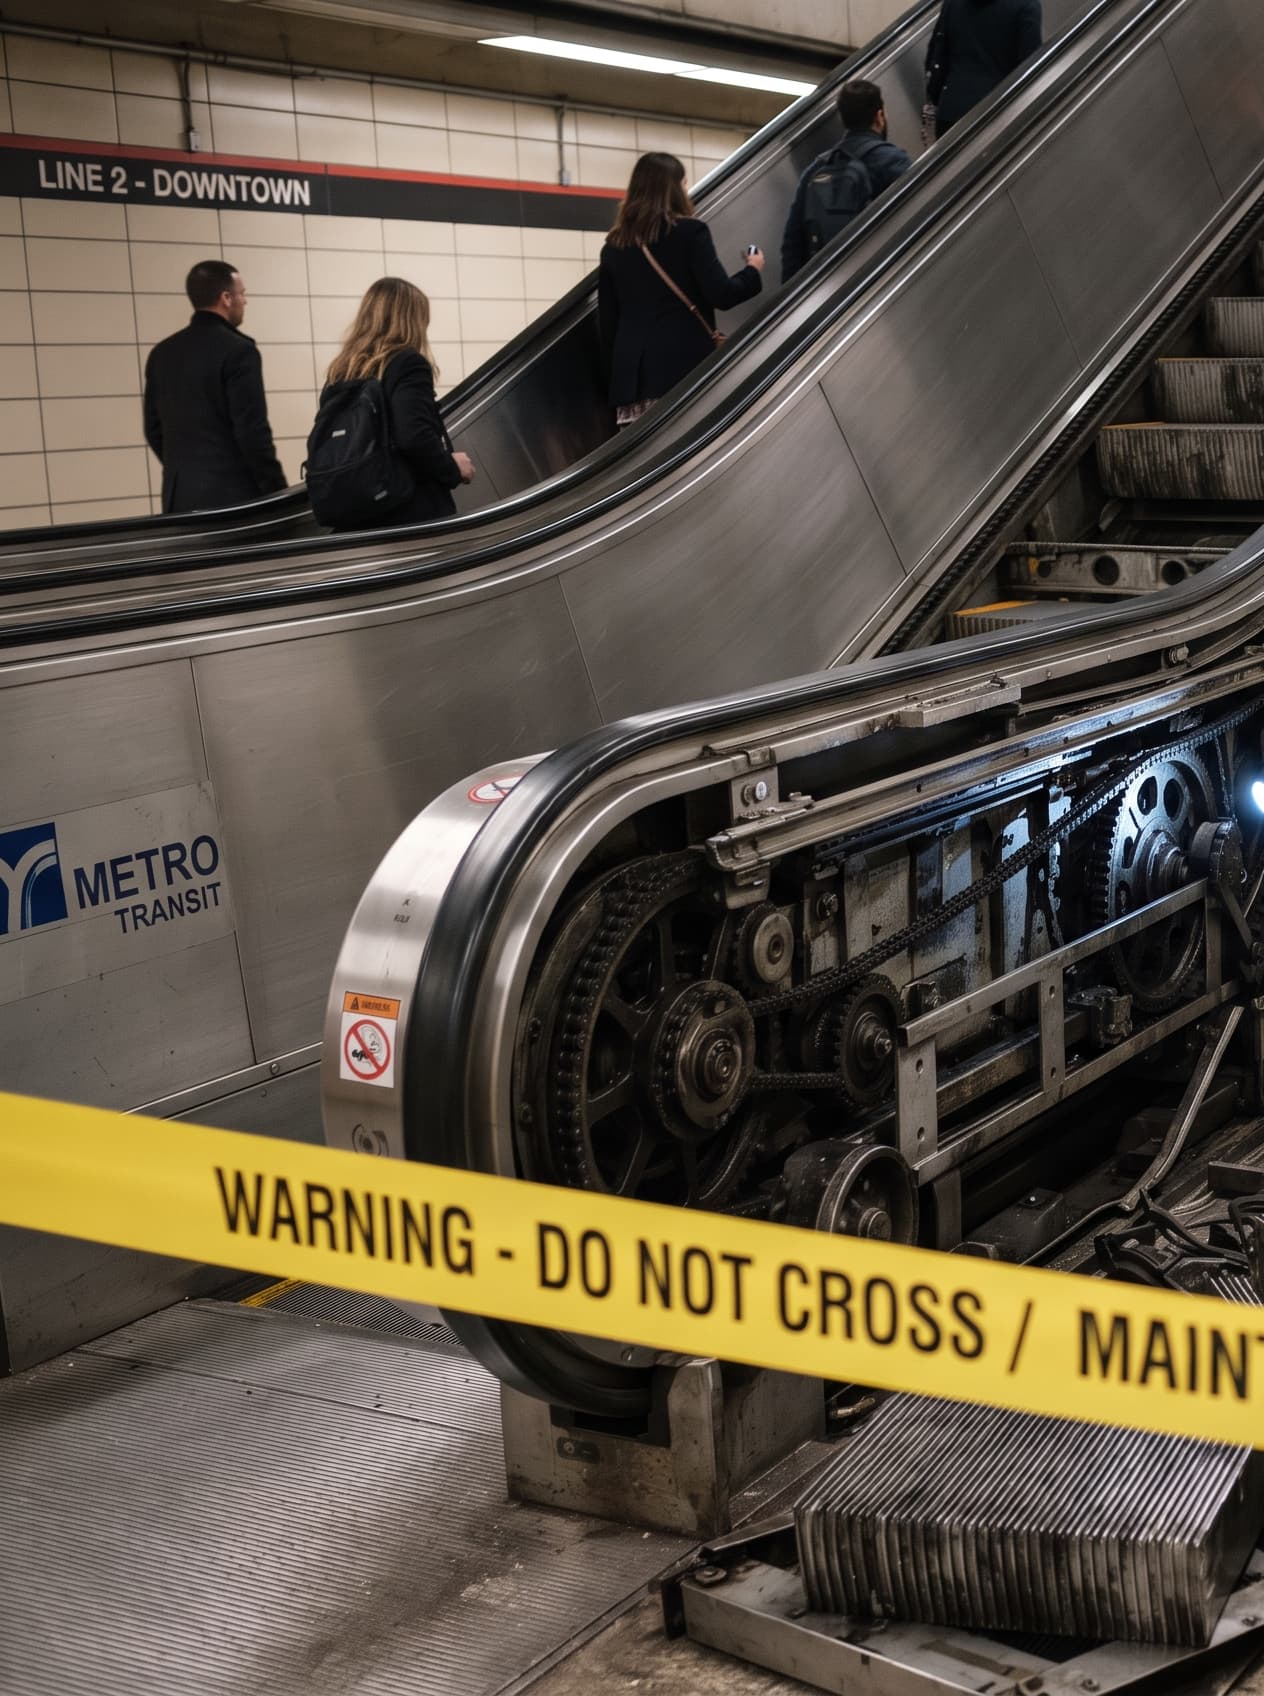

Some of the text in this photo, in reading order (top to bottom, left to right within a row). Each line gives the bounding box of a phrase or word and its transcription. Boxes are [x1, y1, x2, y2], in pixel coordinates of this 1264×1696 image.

[39, 159, 104, 192] LINE
[111, 166, 128, 194] 2
[153, 168, 311, 207] DOWNTOWN
[73, 834, 219, 910] METRO
[114, 882, 221, 934] TRANSIT
[214, 1166, 475, 1277] WARNING
[497, 1247, 513, 1260] -
[536, 1221, 613, 1300] DO
[636, 1238, 754, 1322] NOT
[777, 1262, 986, 1361] CROSS
[1008, 1299, 1034, 1375] /
